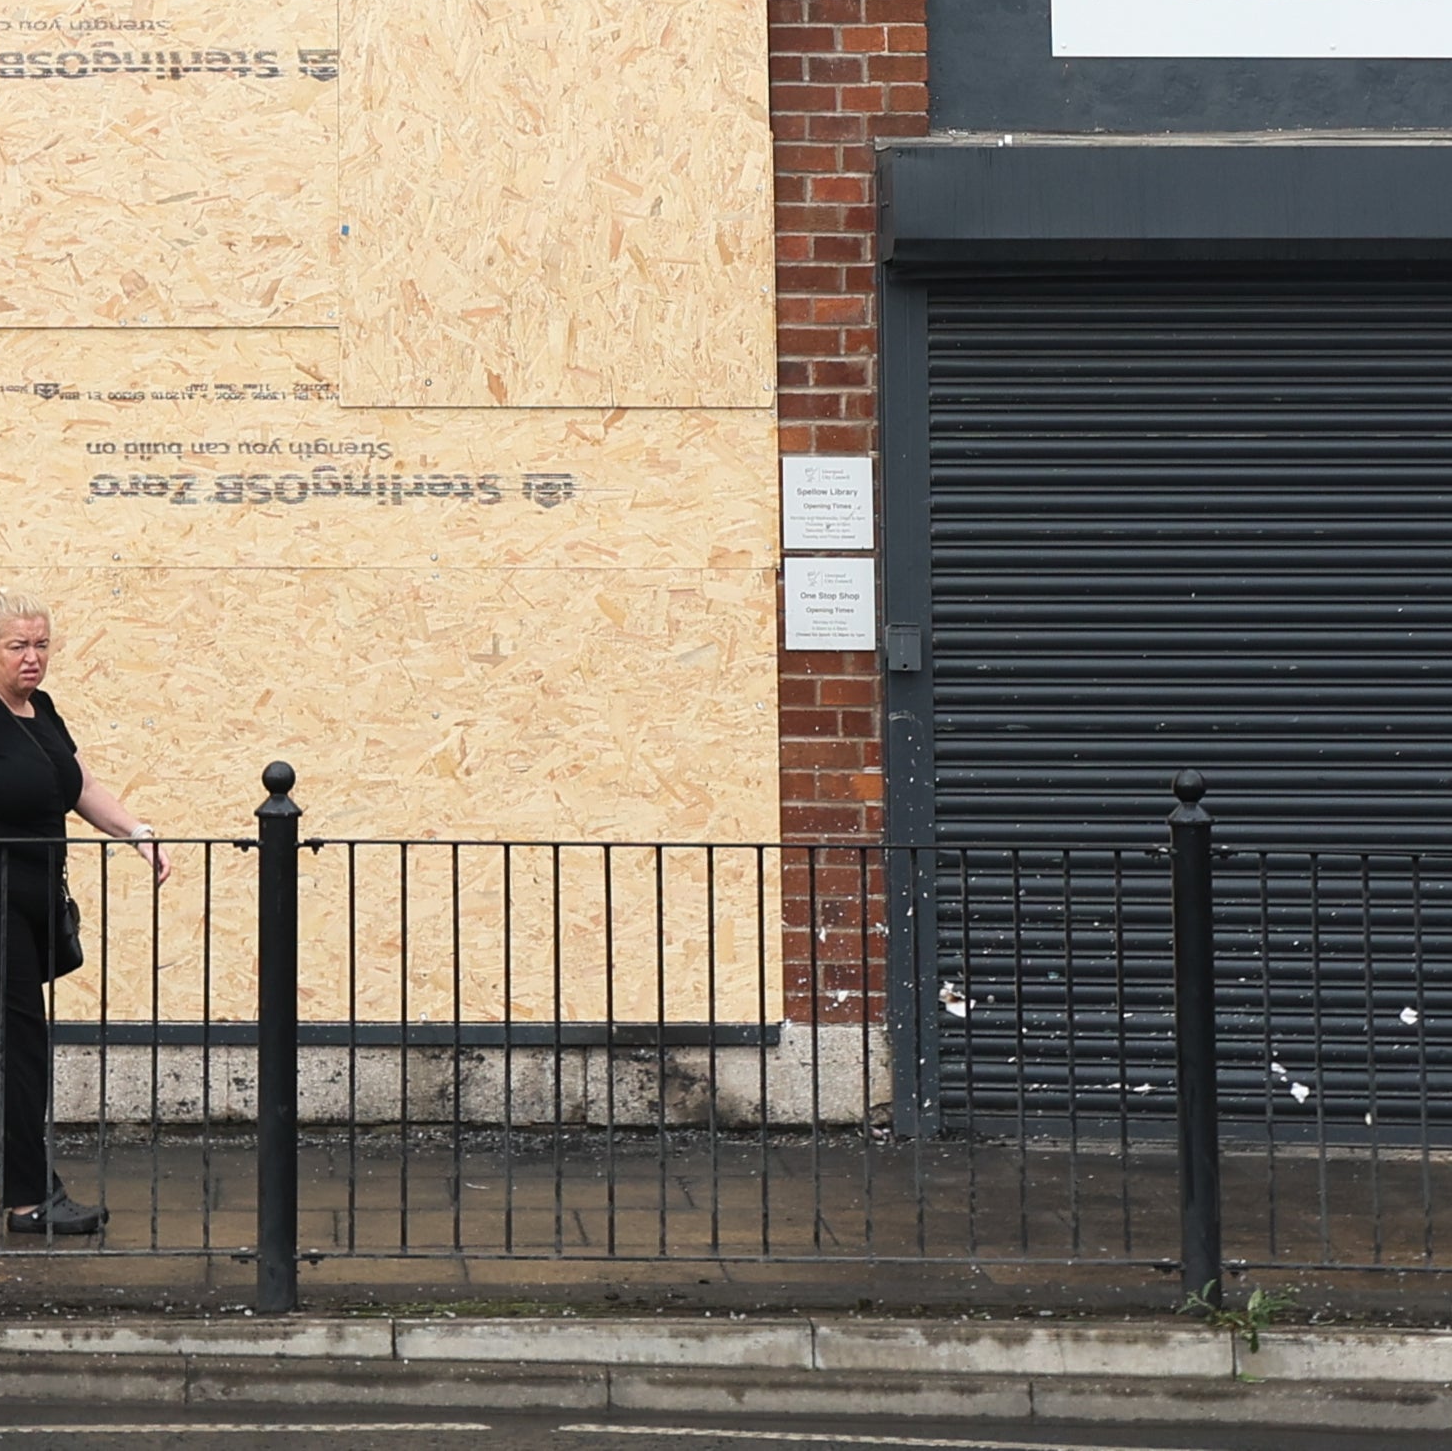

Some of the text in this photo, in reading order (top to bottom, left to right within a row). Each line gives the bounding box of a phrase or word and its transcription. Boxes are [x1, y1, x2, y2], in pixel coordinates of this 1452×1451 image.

[85, 439, 393, 460] Strength you can build on
[800, 592, 860, 602] One Stop Shop
